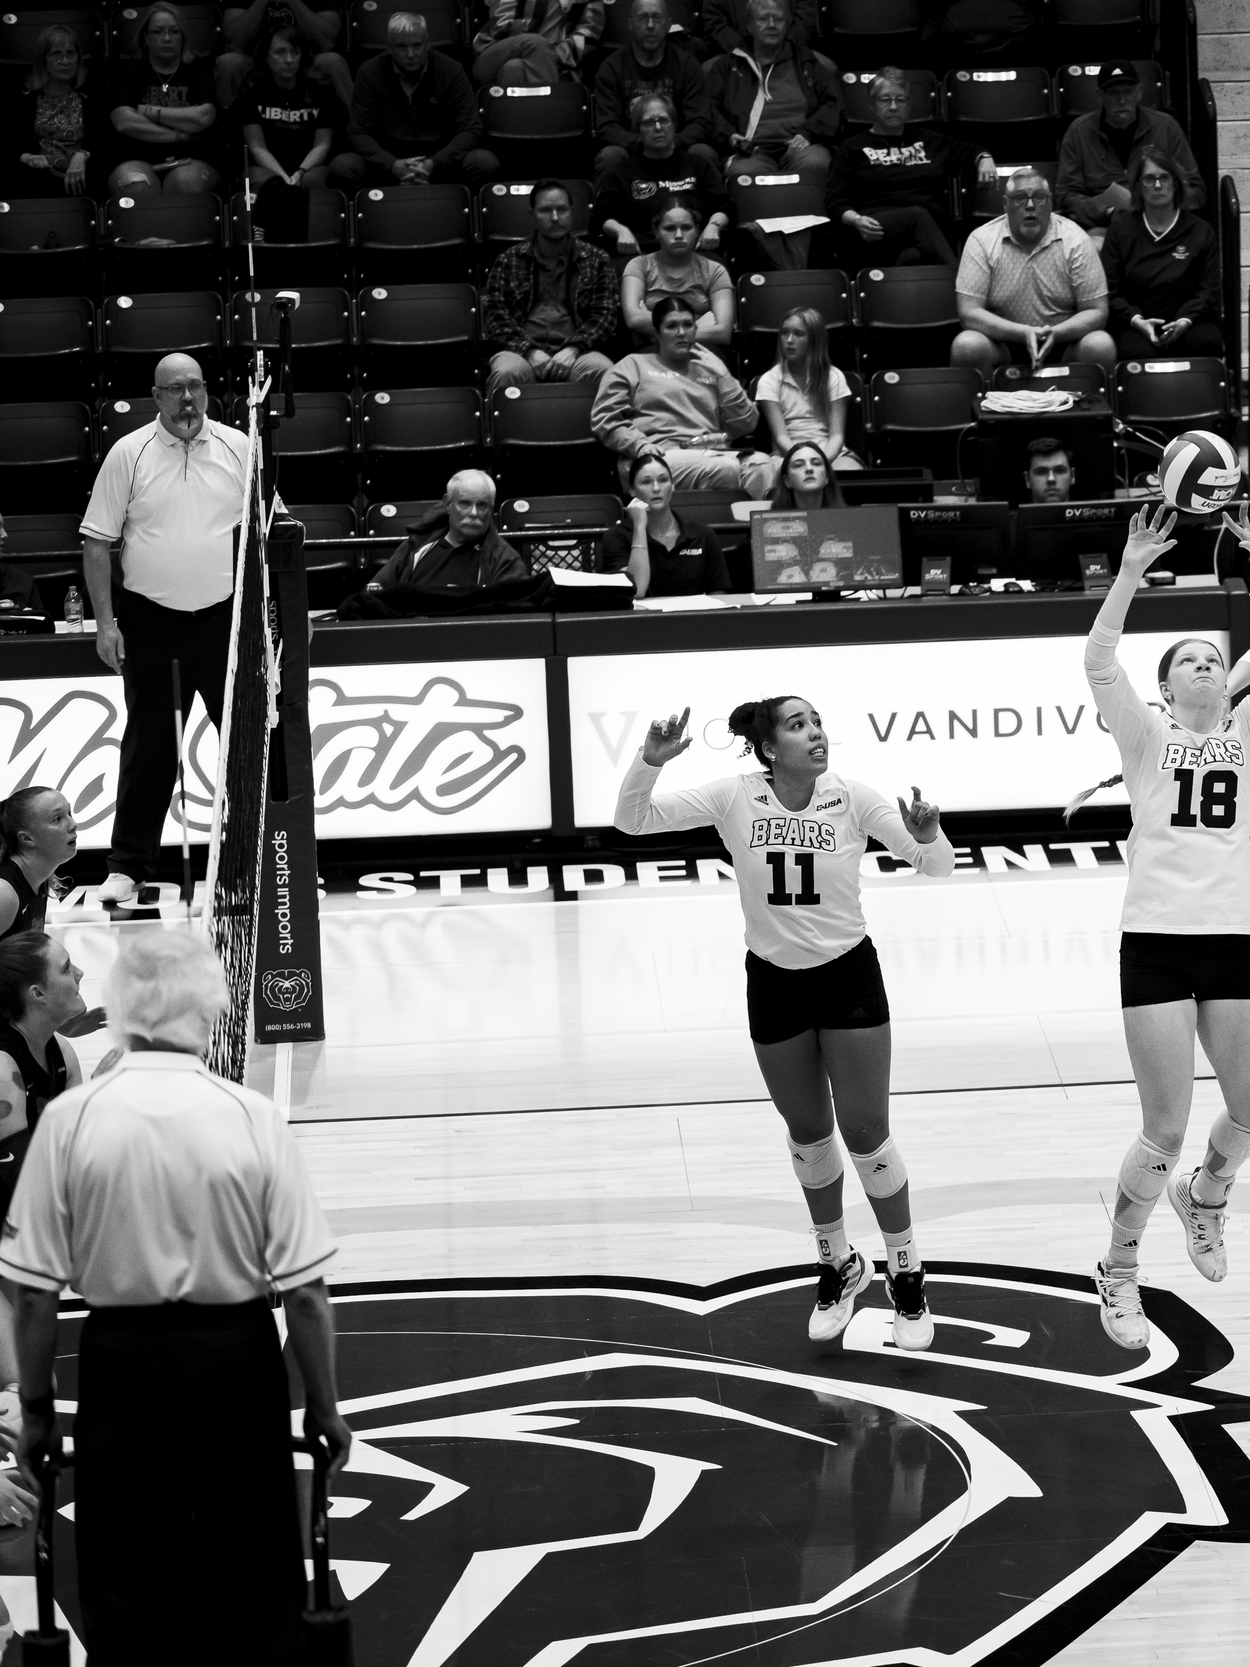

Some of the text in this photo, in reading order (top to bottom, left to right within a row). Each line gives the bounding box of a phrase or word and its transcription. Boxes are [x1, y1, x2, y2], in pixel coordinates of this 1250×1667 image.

[257, 104, 320, 123] LIBERTY
[867, 701, 1112, 742] VANDIV
[1162, 737, 1245, 770] BEARS
[1170, 768, 1238, 829] 18
[750, 817, 837, 852] BEARS
[272, 830, 291, 885] sports
[356, 858, 740, 899] STUDEN
[766, 851, 821, 906] 11
[265, 1022, 312, 1031] (800) 556-3198
